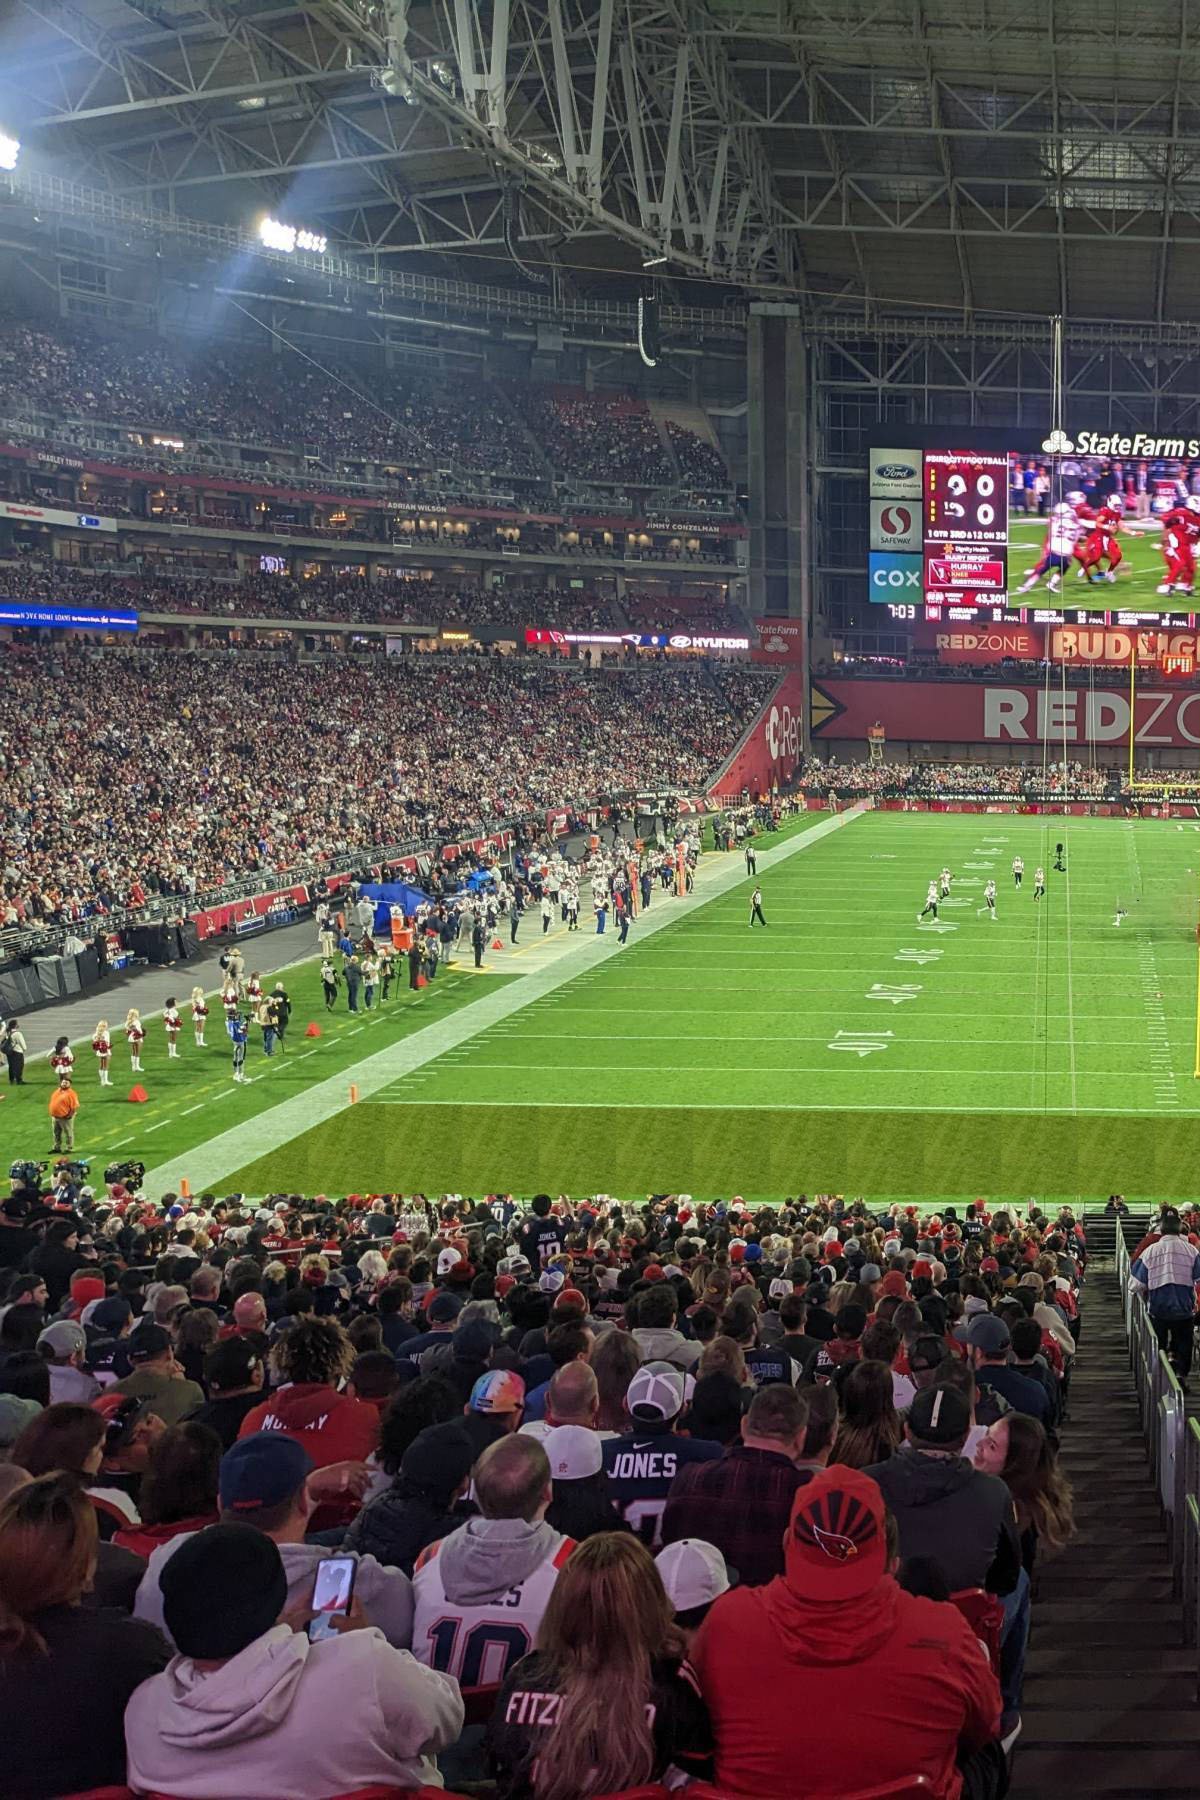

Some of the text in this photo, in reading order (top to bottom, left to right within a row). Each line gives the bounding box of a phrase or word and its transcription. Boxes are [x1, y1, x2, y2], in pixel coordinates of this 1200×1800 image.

[883, 467, 908, 477] Ford
[977, 475, 994, 496] 0
[977, 504, 994, 525] 0
[873, 570, 920, 587] COX
[888, 604, 915, 619] 7:03
[693, 637, 749, 649] HYUNDAI
[936, 634, 1029, 651] REDZONE
[1053, 631, 1131, 660] BUD
[865, 983, 923, 1000] 20
[827, 1030, 895, 1051] 10
[261, 1413, 328, 1431] MUAY
[607, 1452, 677, 1478] JONES
[427, 1616, 532, 1689] 10
